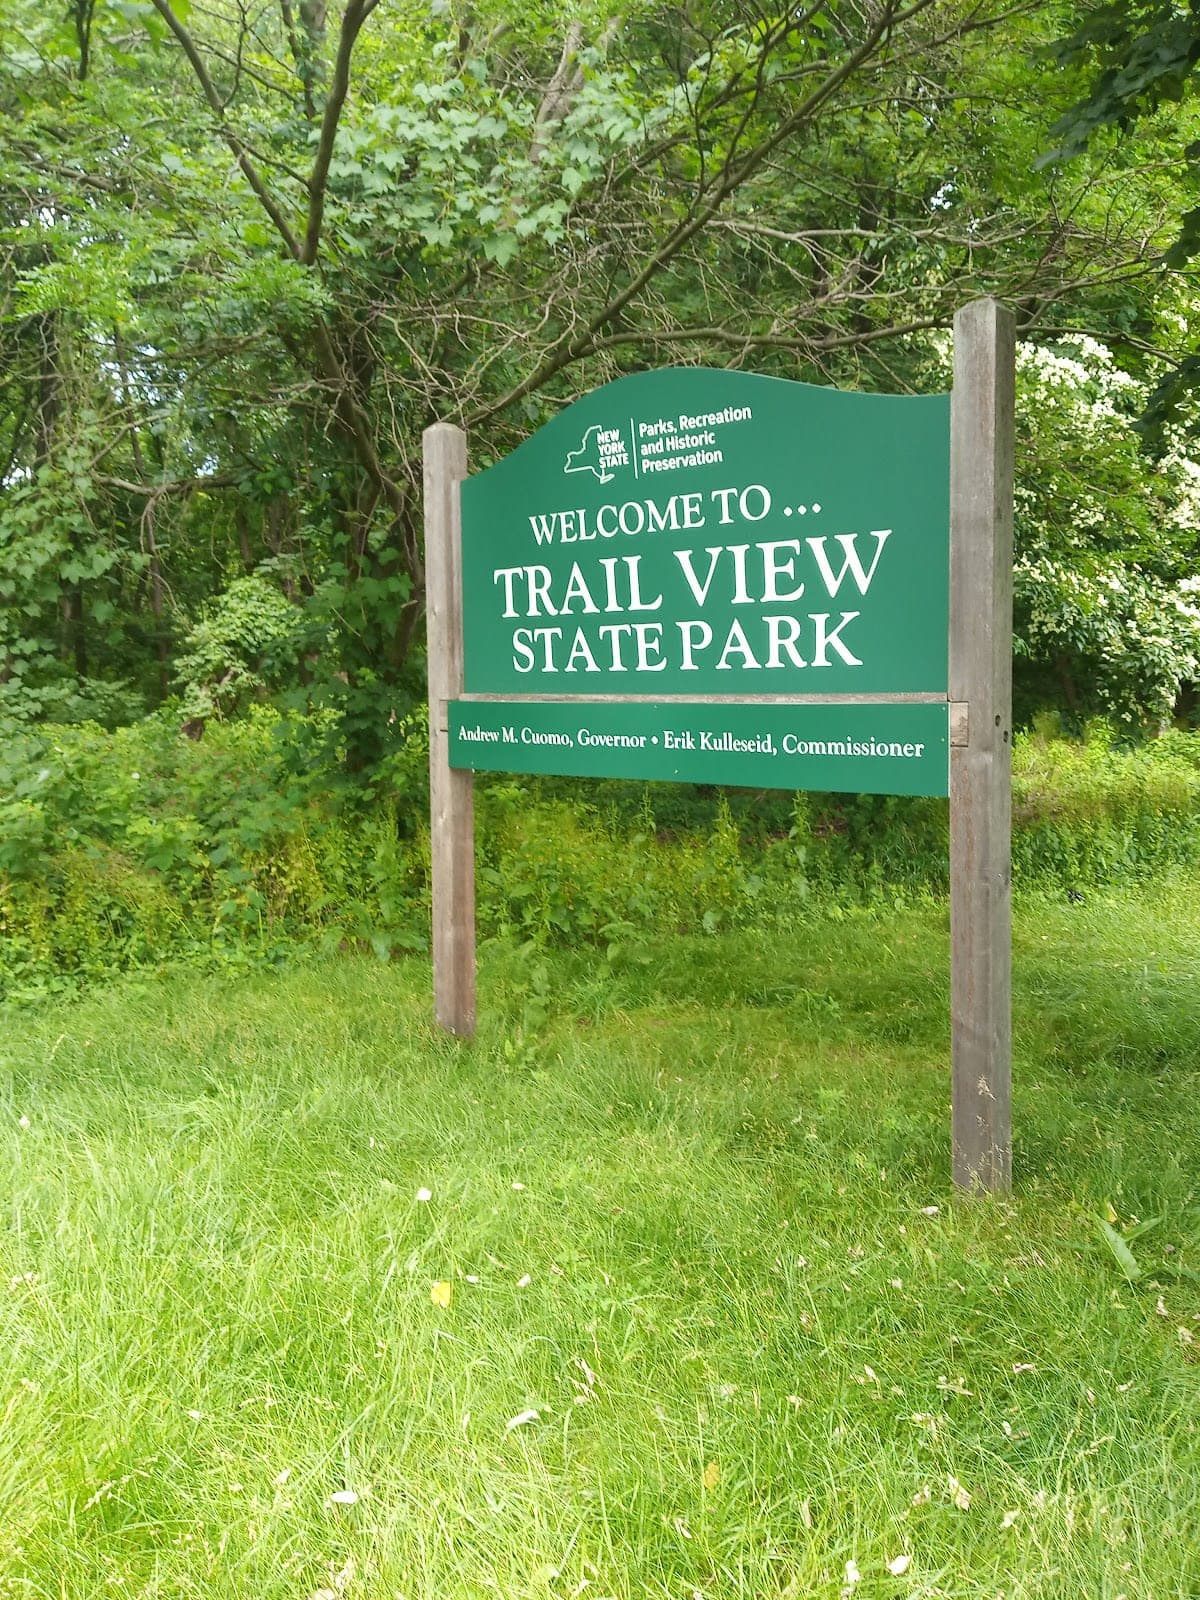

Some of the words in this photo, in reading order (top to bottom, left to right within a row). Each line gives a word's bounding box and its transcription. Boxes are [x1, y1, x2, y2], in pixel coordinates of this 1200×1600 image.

[597, 429, 620, 443] NEW
[639, 419, 677, 438] Parks,
[679, 406, 752, 430] Recreation
[598, 441, 626, 456] YORK
[641, 437, 664, 456] and
[666, 430, 715, 452] Historic
[599, 453, 629, 469] STATE
[642, 449, 723, 473] Preservation
[529, 492, 706, 546] WELCOME
[711, 485, 772, 525] TO
[494, 555, 663, 619] TRAIL
[673, 529, 893, 607] VIEW
[512, 623, 668, 673] STATE
[675, 611, 864, 670] PARK
[458, 725, 500, 743] Andrew
[501, 727, 519, 744] M.
[521, 728, 574, 748] Cuomo,
[577, 729, 647, 748] Governor
[663, 731, 697, 750] Erik
[699, 732, 778, 756] Kulleseid,
[782, 733, 925, 758] Commissioner
